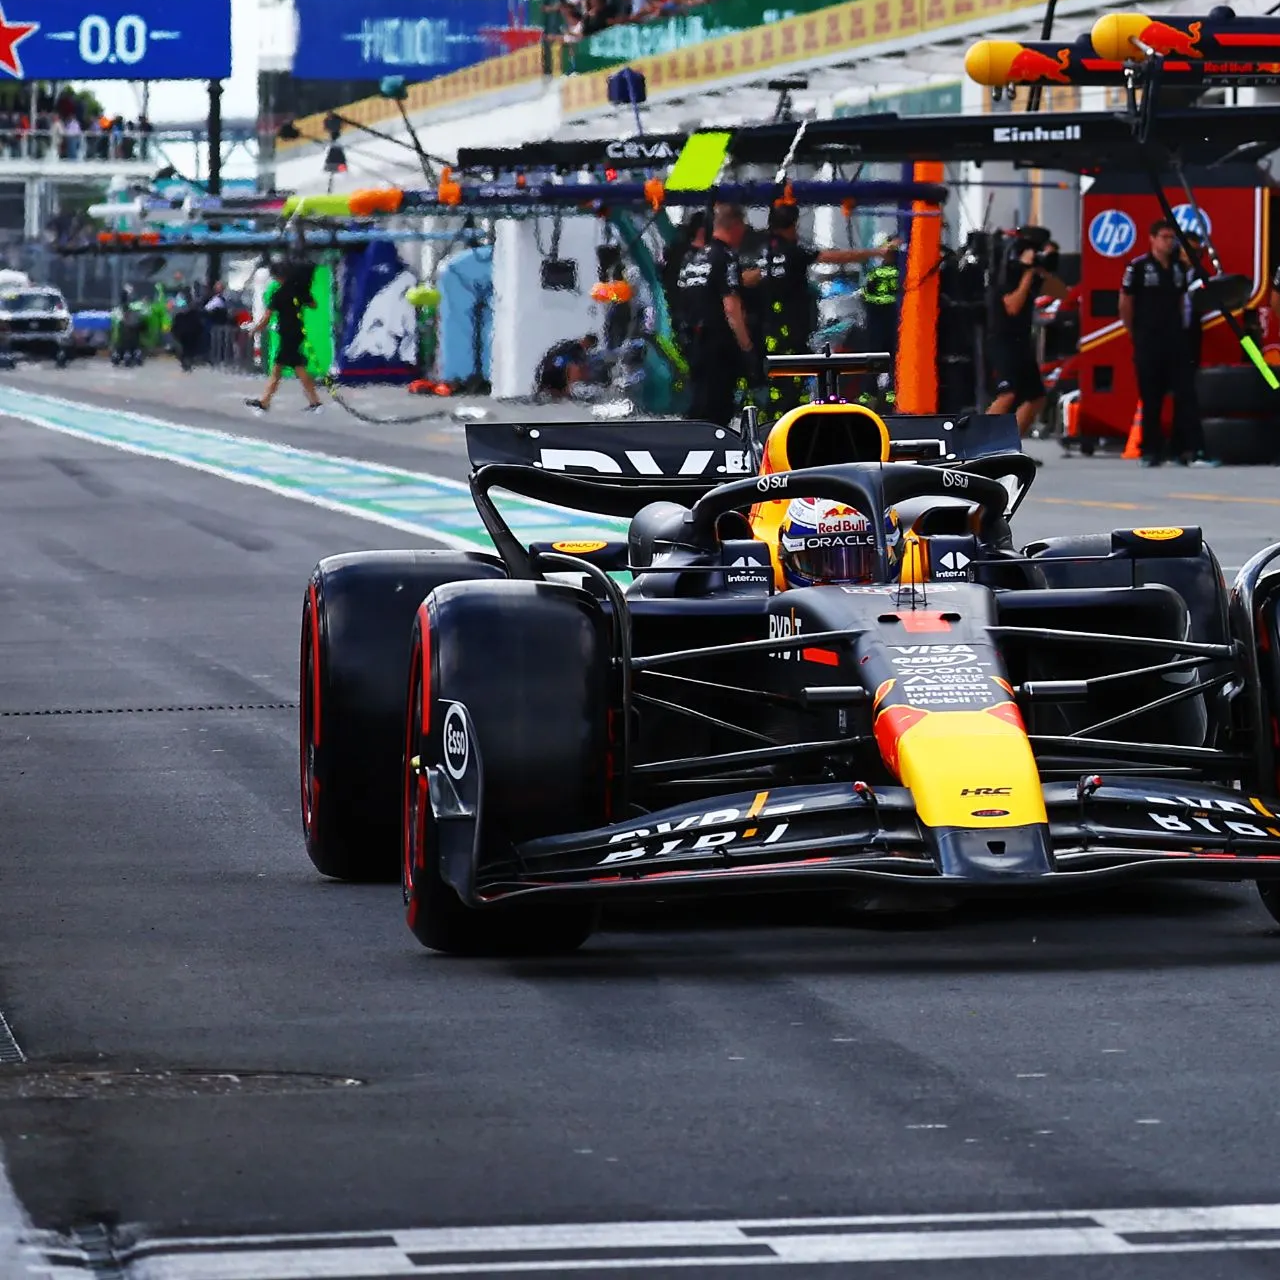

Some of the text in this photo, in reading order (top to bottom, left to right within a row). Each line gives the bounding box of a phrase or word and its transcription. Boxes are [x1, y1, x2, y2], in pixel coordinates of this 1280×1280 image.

[993, 126, 1082, 143] Einhell
[1095, 210, 1131, 256] hp
[770, 475, 789, 490] Sui
[818, 519, 866, 534] Red Bull
[806, 535, 875, 549] ORACLE
[727, 573, 769, 583] inter.mx
[886, 644, 975, 655] VISA
[897, 666, 983, 676] zoom
[907, 696, 971, 706] Mobil
[960, 786, 1013, 796] HRC
